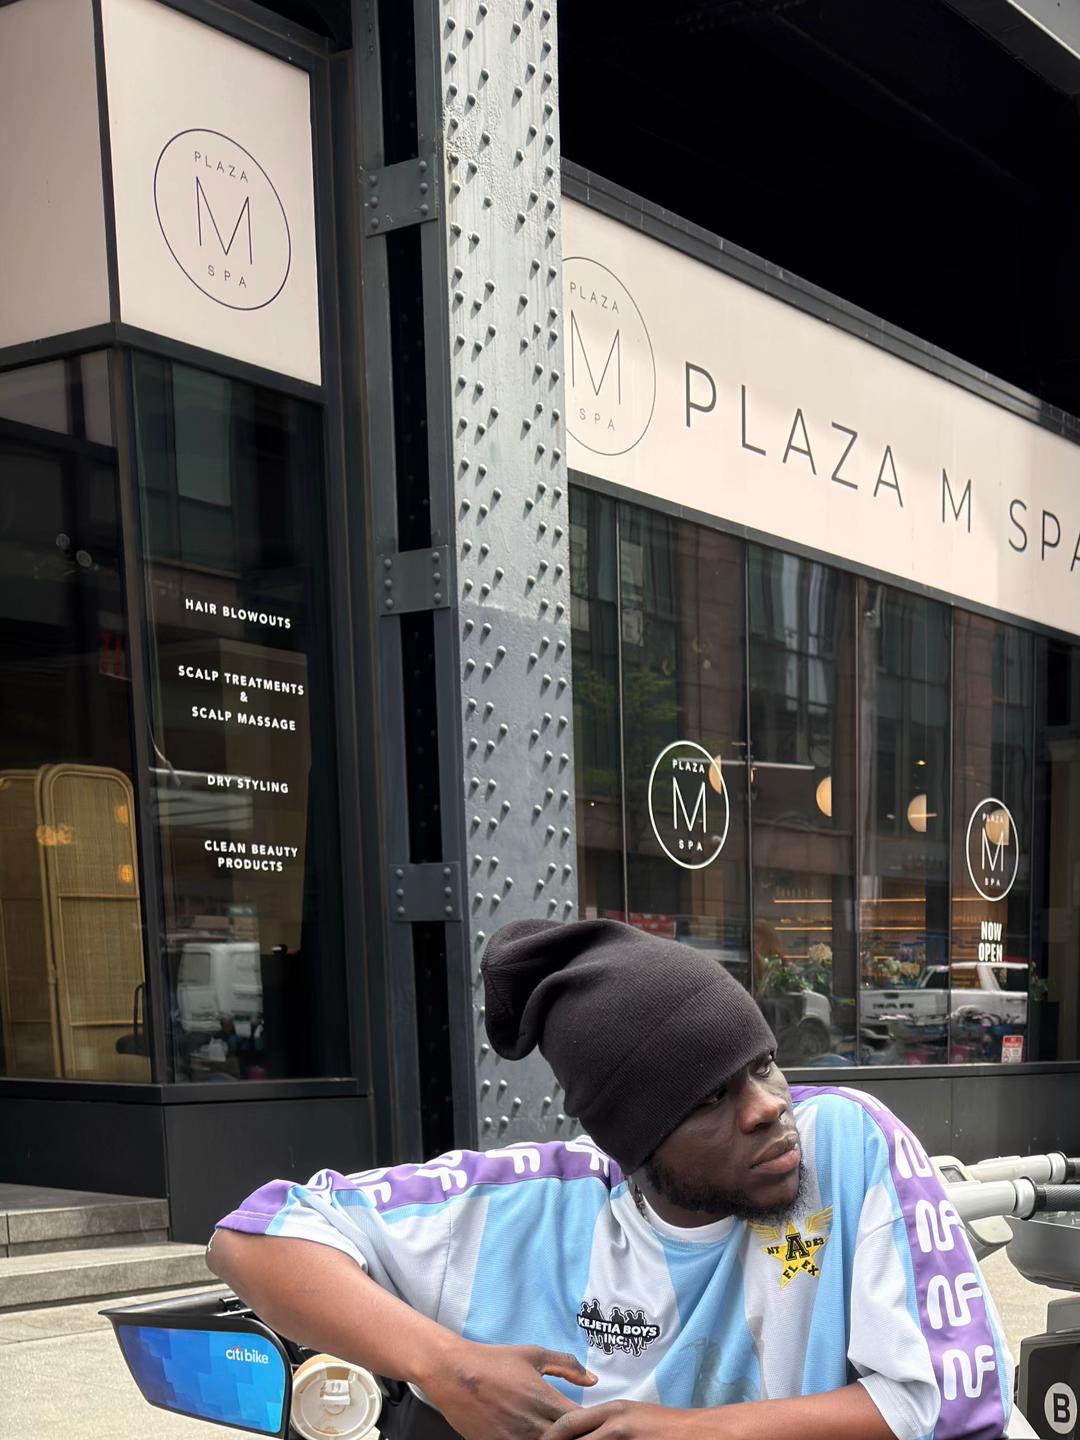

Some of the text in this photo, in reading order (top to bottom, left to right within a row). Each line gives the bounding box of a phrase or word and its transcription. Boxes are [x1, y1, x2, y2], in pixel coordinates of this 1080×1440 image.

[194, 151, 248, 183] PLAZA
[195, 176, 253, 265] M
[207, 265, 247, 288] SPA
[569, 281, 619, 313] PLAZA
[570, 309, 622, 404] M
[579, 408, 616, 430] SPA
[684, 361, 904, 508] PLAZA
[941, 468, 972, 533] M
[185, 598, 291, 629] HAIR BLOWOUTS
[178, 665, 304, 695] SCALP TREATMENTS
[240, 691, 248, 702] &
[191, 706, 296, 731] SCALP MASSAGE
[672, 759, 705, 774] PLAZA
[207, 774, 289, 793] DRY STYLING
[672, 776, 707, 834] M
[982, 812, 1005, 825] PLAZA
[204, 840, 298, 857] CLEAN BEAUTY
[678, 839, 703, 852] SPA
[981, 827, 1004, 872] M
[217, 857, 283, 872] PRODUCTS
[984, 877, 1001, 887] SPA
[981, 921, 1002, 942] NOW
[978, 942, 1003, 962] OPEN
[785, 1233, 810, 1261] A
[577, 1315, 657, 1337] KEJETIA BOYS
[603, 1333, 628, 1346] INC.
[225, 1346, 269, 1364] citi bike
[1053, 1392, 1071, 1424] B
